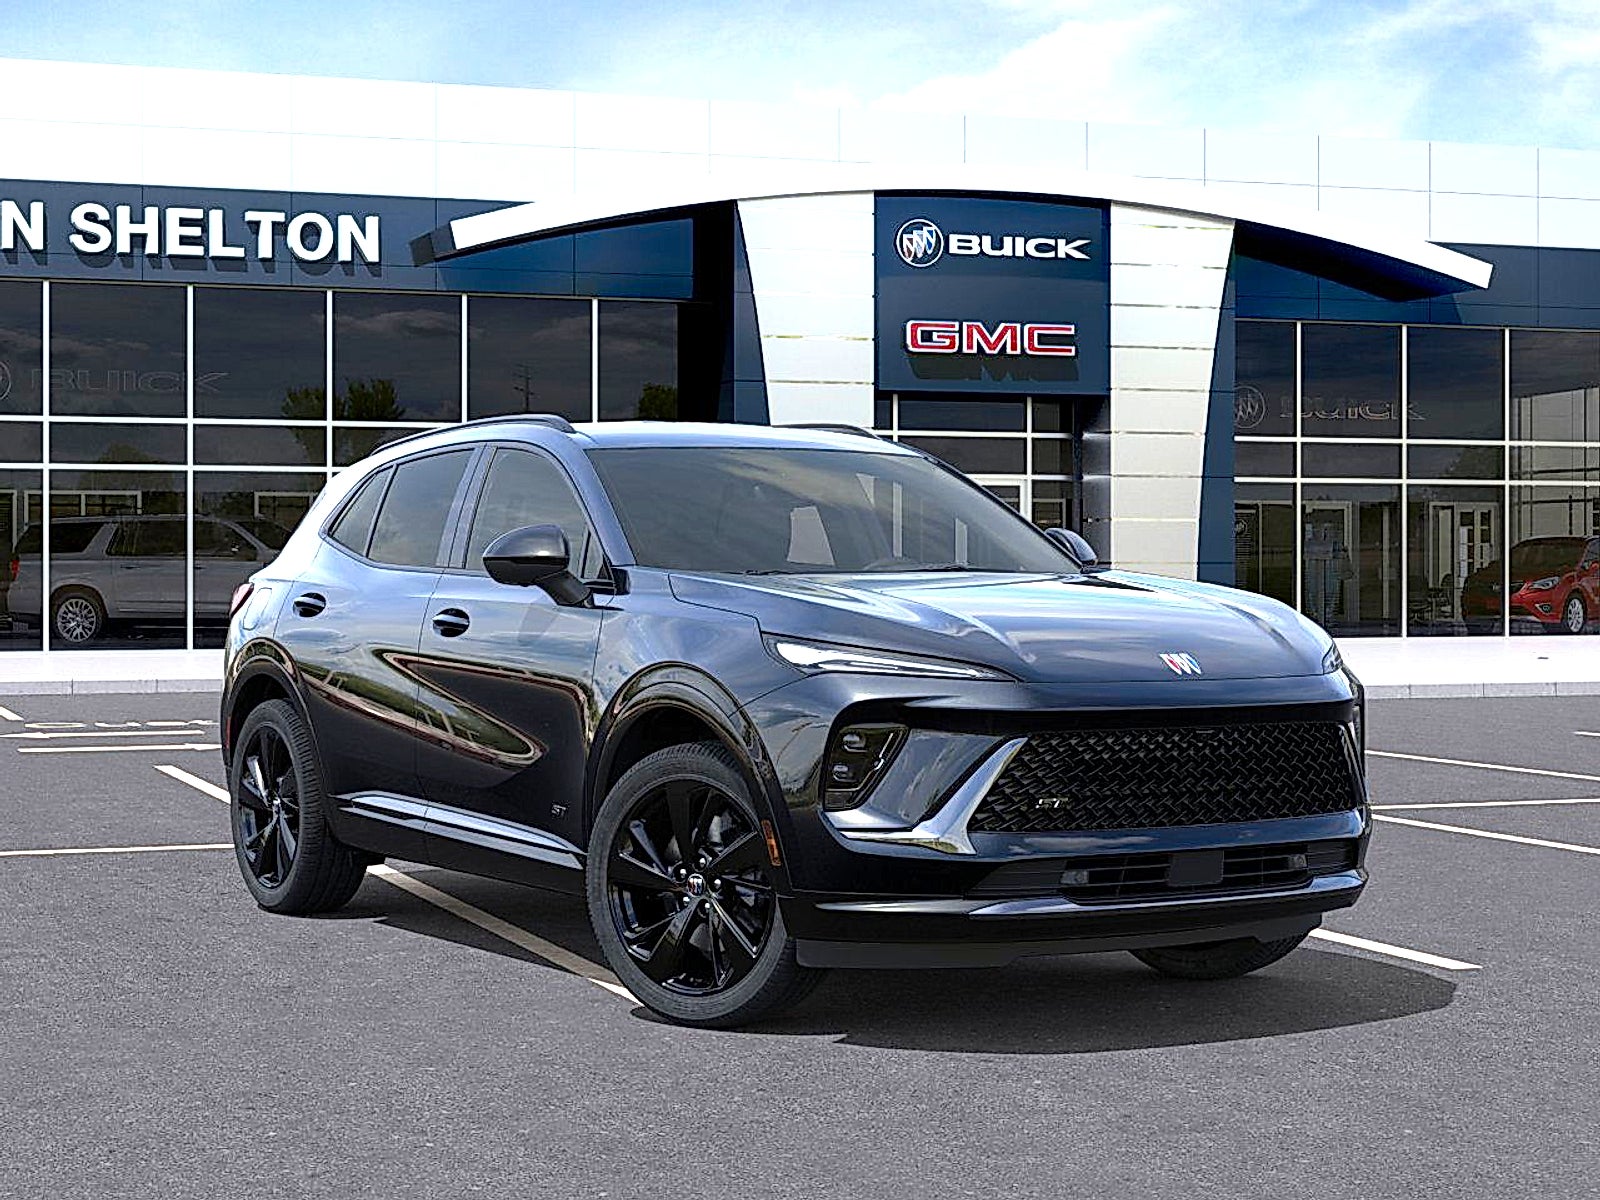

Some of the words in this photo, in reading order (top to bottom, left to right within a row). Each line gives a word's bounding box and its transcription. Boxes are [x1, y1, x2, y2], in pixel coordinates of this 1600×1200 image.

[1, 200, 44, 250] N
[69, 202, 380, 263] SHELTON
[948, 233, 1092, 260] BUICK
[906, 320, 1076, 356] GMC
